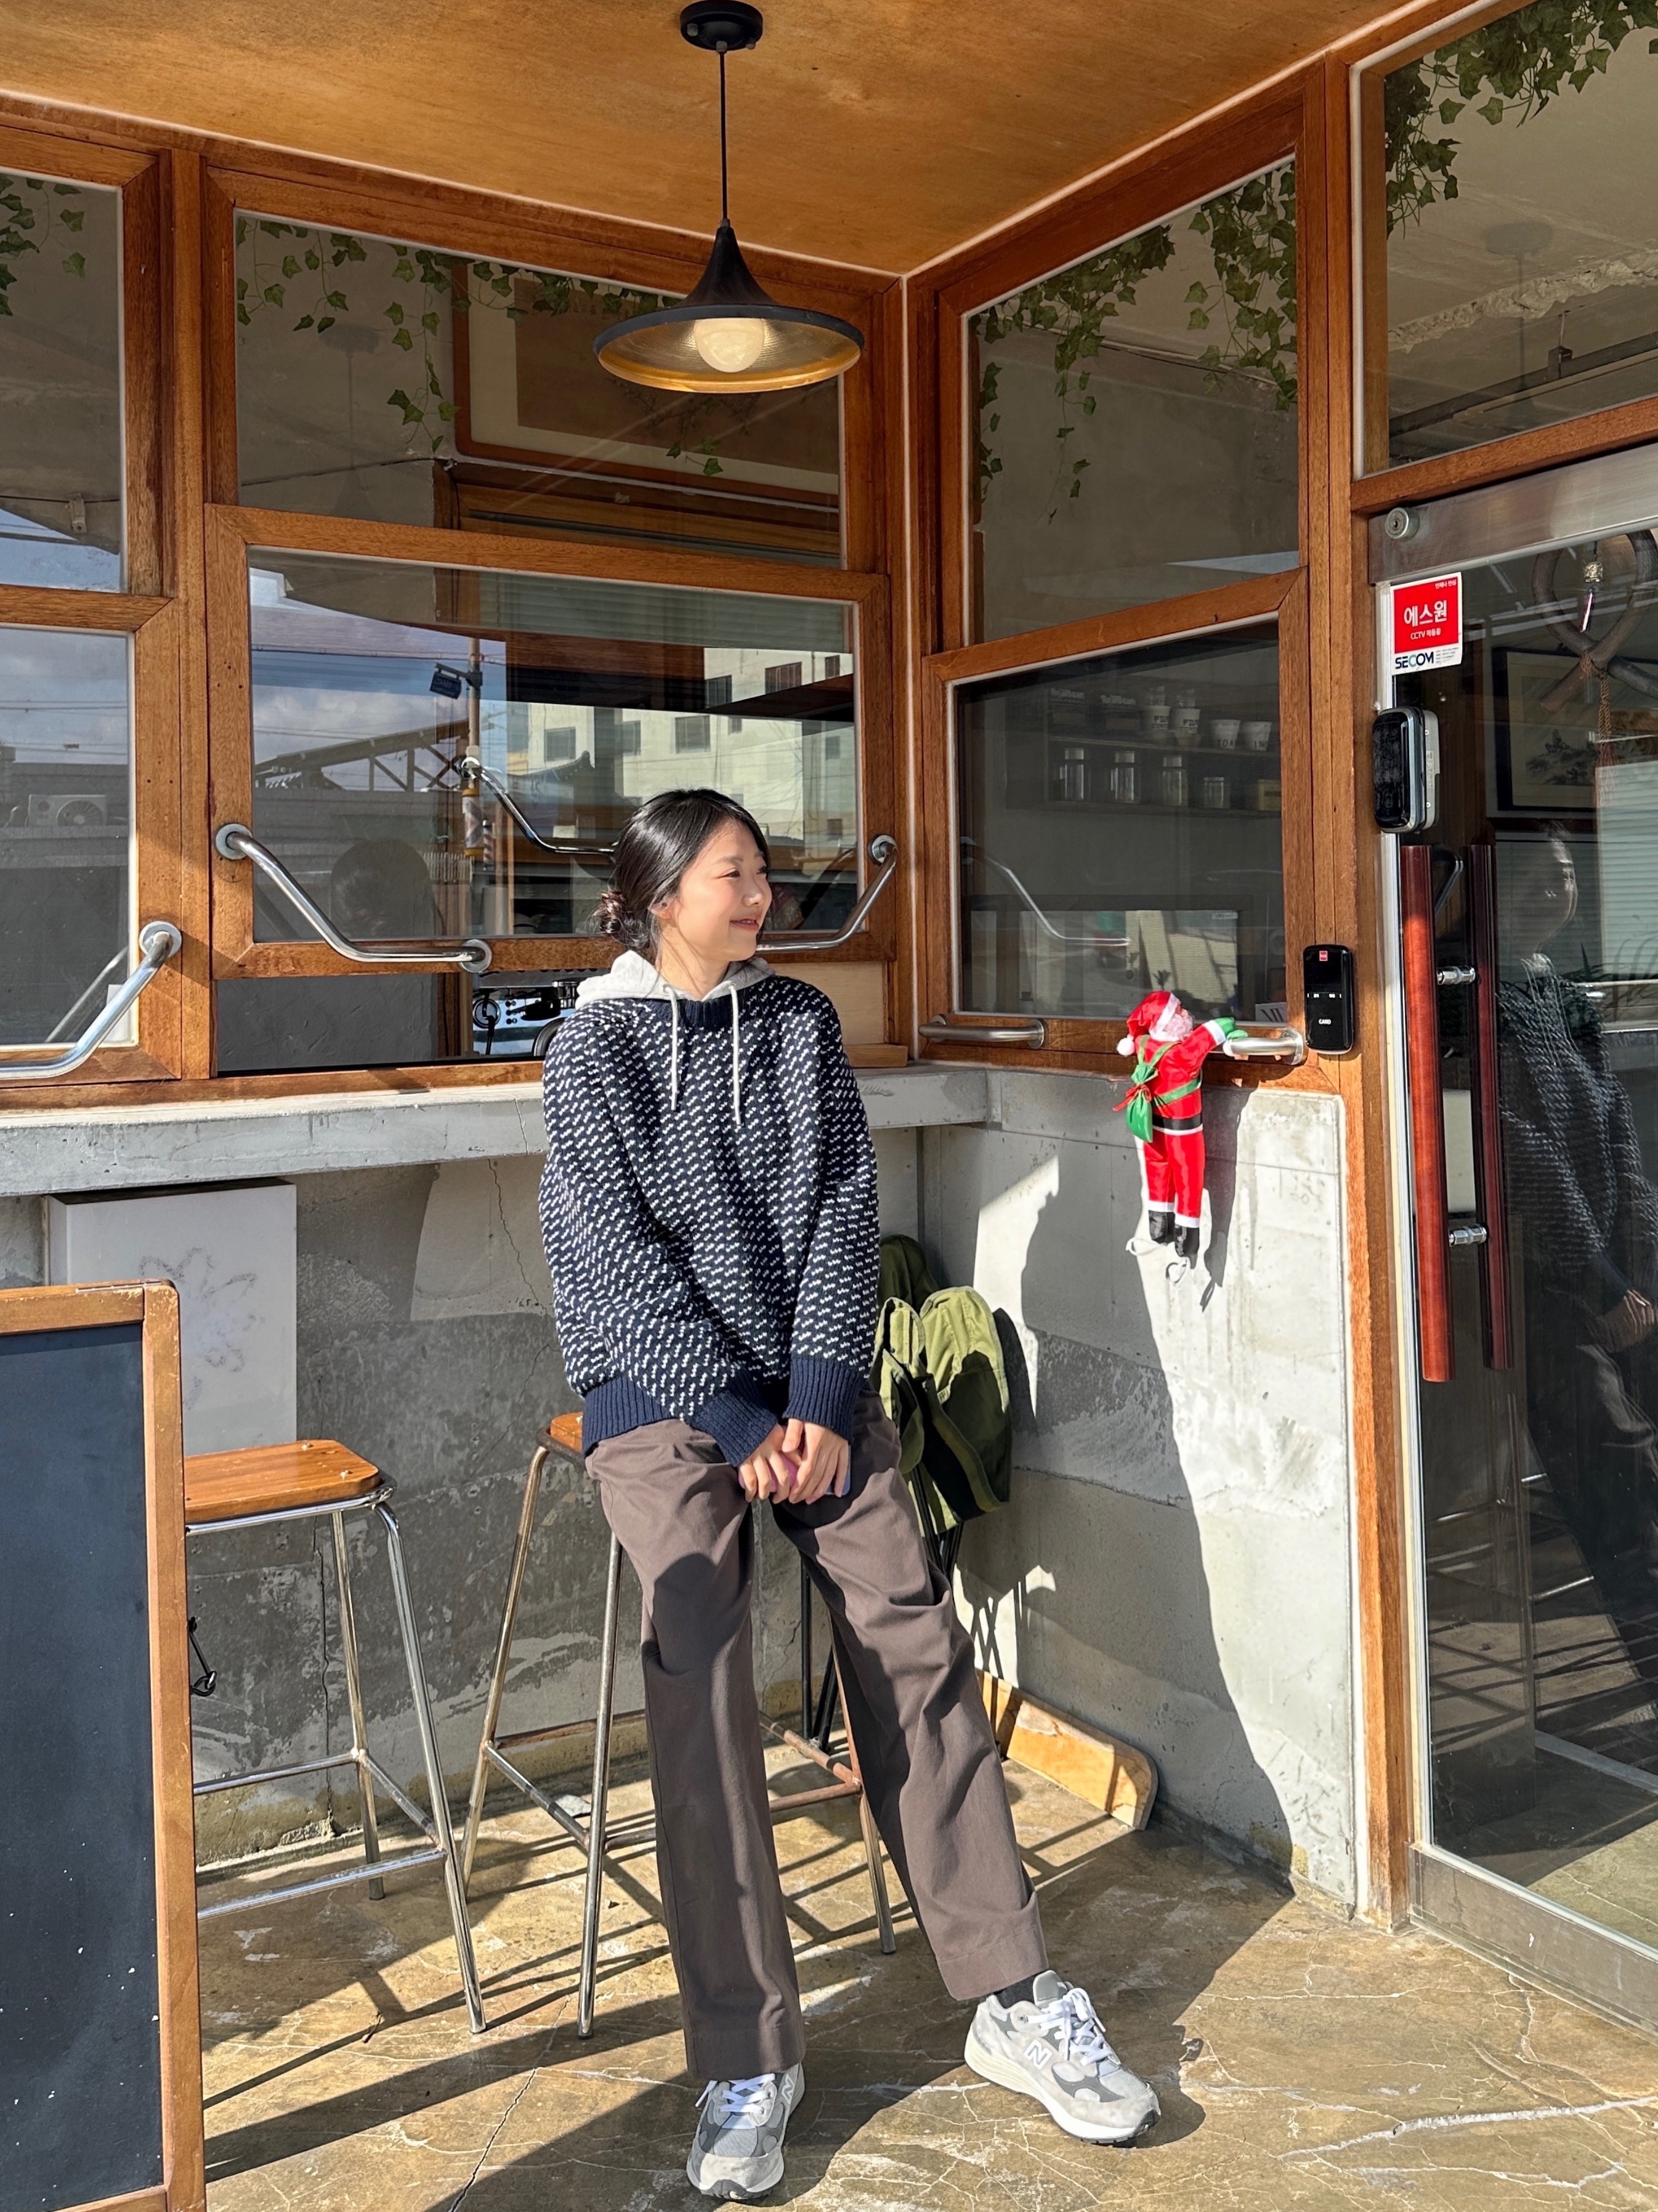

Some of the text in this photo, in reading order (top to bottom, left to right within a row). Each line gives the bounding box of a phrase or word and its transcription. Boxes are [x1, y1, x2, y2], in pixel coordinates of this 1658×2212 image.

[1404, 599, 1447, 627] 에스원
[1410, 630, 1426, 640] CCTV
[1395, 651, 1434, 670] SECOM
[1024, 2040, 1053, 2069] N
